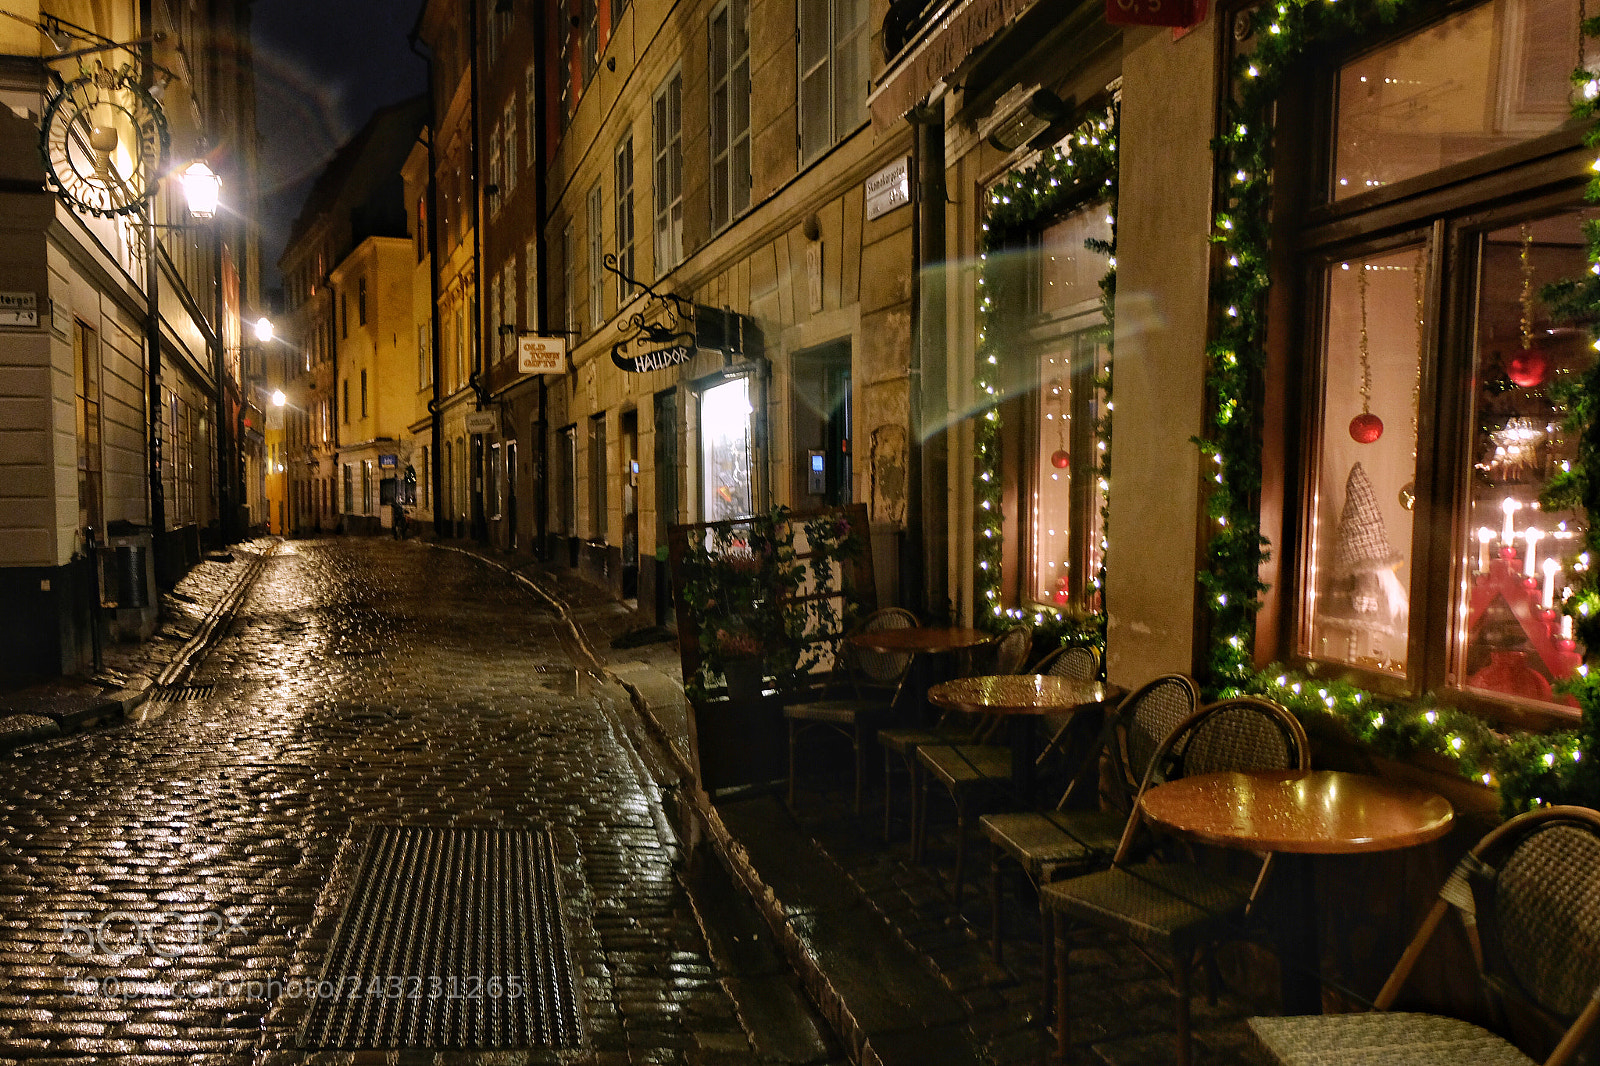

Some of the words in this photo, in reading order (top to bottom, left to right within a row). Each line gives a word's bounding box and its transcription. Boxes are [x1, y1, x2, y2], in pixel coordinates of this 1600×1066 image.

[523, 343, 546, 352] OLD
[529, 352, 560, 361] TOWN
[634, 346, 691, 374] HALLDOR
[523, 359, 557, 368] GIFTS
